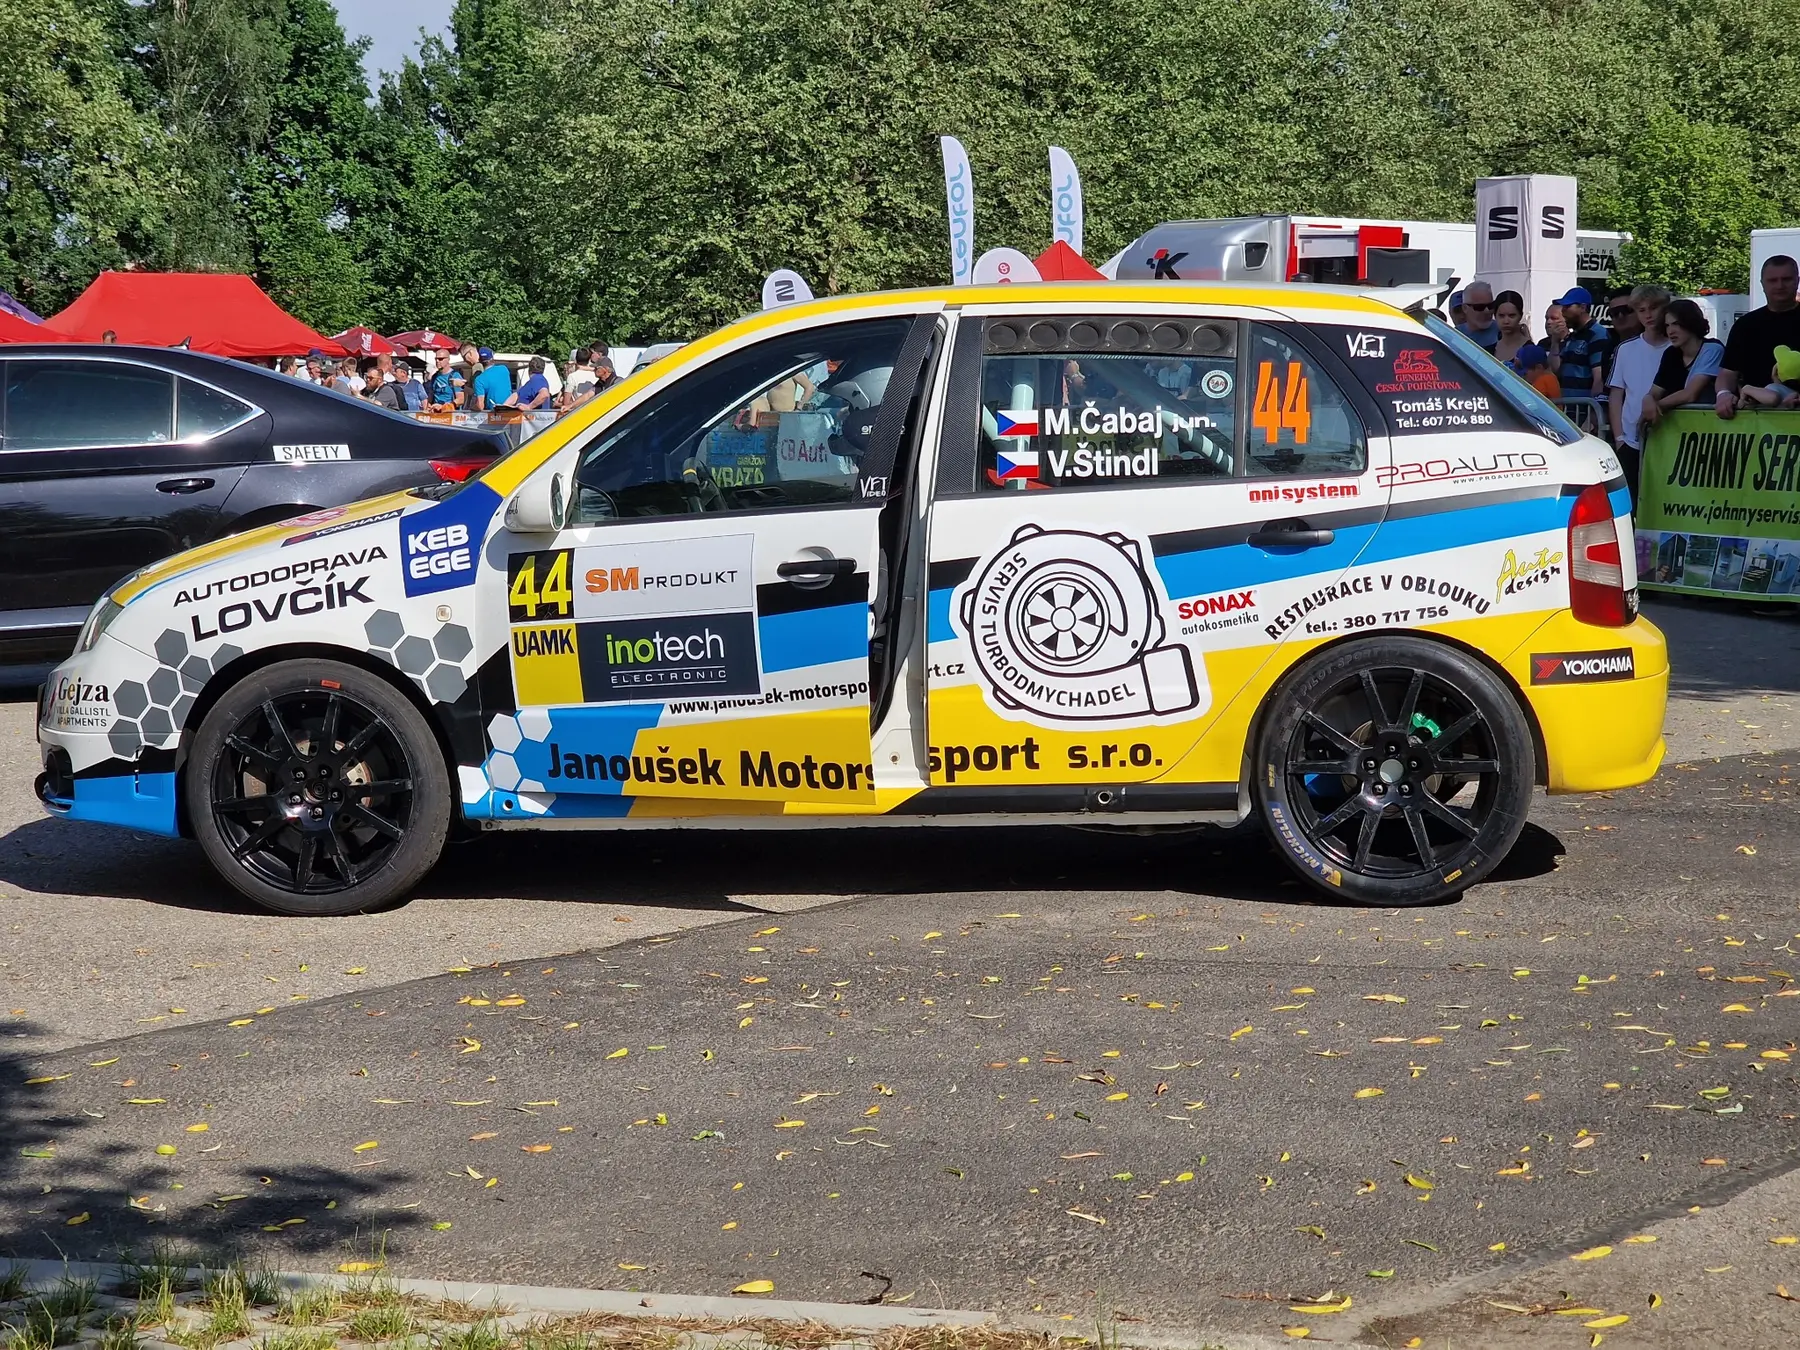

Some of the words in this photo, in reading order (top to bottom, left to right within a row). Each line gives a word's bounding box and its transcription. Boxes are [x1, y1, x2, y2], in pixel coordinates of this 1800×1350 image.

[1376, 381, 1405, 393] ČESKÁ
[1396, 373, 1440, 382] GENERALI
[1253, 361, 1310, 444] 44
[1392, 398, 1443, 413] Tomáš
[1045, 401, 1162, 438] M.Čabaj
[1396, 417, 1420, 428] Tel.:
[1422, 417, 1444, 427] 607
[1446, 416, 1468, 426] 704
[1470, 415, 1493, 425] 880
[282, 446, 339, 460] SAFETY
[1047, 442, 1159, 479] V.Štindl
[1375, 453, 1547, 484] PROAUTO
[1667, 432, 1755, 489] JOHNNY
[1753, 433, 1800, 492] SER
[1453, 471, 1549, 485] WWW.PROAUTOCZ.CZ
[316, 511, 399, 536] YOKOHAMA
[408, 524, 469, 555] KEB
[173, 546, 388, 607] AUTODOPRAVA
[410, 548, 471, 579] EGE
[1496, 547, 1564, 604] Auto
[509, 552, 572, 617] 44
[585, 567, 639, 593] SM
[643, 571, 738, 589] PRODUKT
[982, 552, 1027, 615] SERVIS
[1505, 565, 1561, 596] design
[191, 572, 375, 642] LOVČÍK
[1178, 590, 1256, 620] SONAX
[1264, 576, 1373, 641] RESTAURACE
[1380, 575, 1393, 591] V
[1400, 575, 1491, 615] OBLOUKU
[1305, 620, 1338, 634] tel.:
[1343, 614, 1377, 629] 380
[1382, 610, 1411, 624] 717
[1416, 605, 1449, 619] 756
[1181, 611, 1259, 635] autokosmetika
[513, 629, 576, 658] UAMK
[606, 628, 725, 664] inotech
[611, 670, 727, 684] ELECTRONIC
[981, 621, 1135, 708] TURBODMYCHADEL
[1563, 656, 1633, 676] YOKOHAMA
[58, 676, 110, 706] Gejza
[70, 706, 111, 716] GALLISTL
[548, 743, 726, 786] Janoušek
[1067, 742, 1163, 769] s.r.o.
[1272, 807, 1320, 870] MICHELIN
